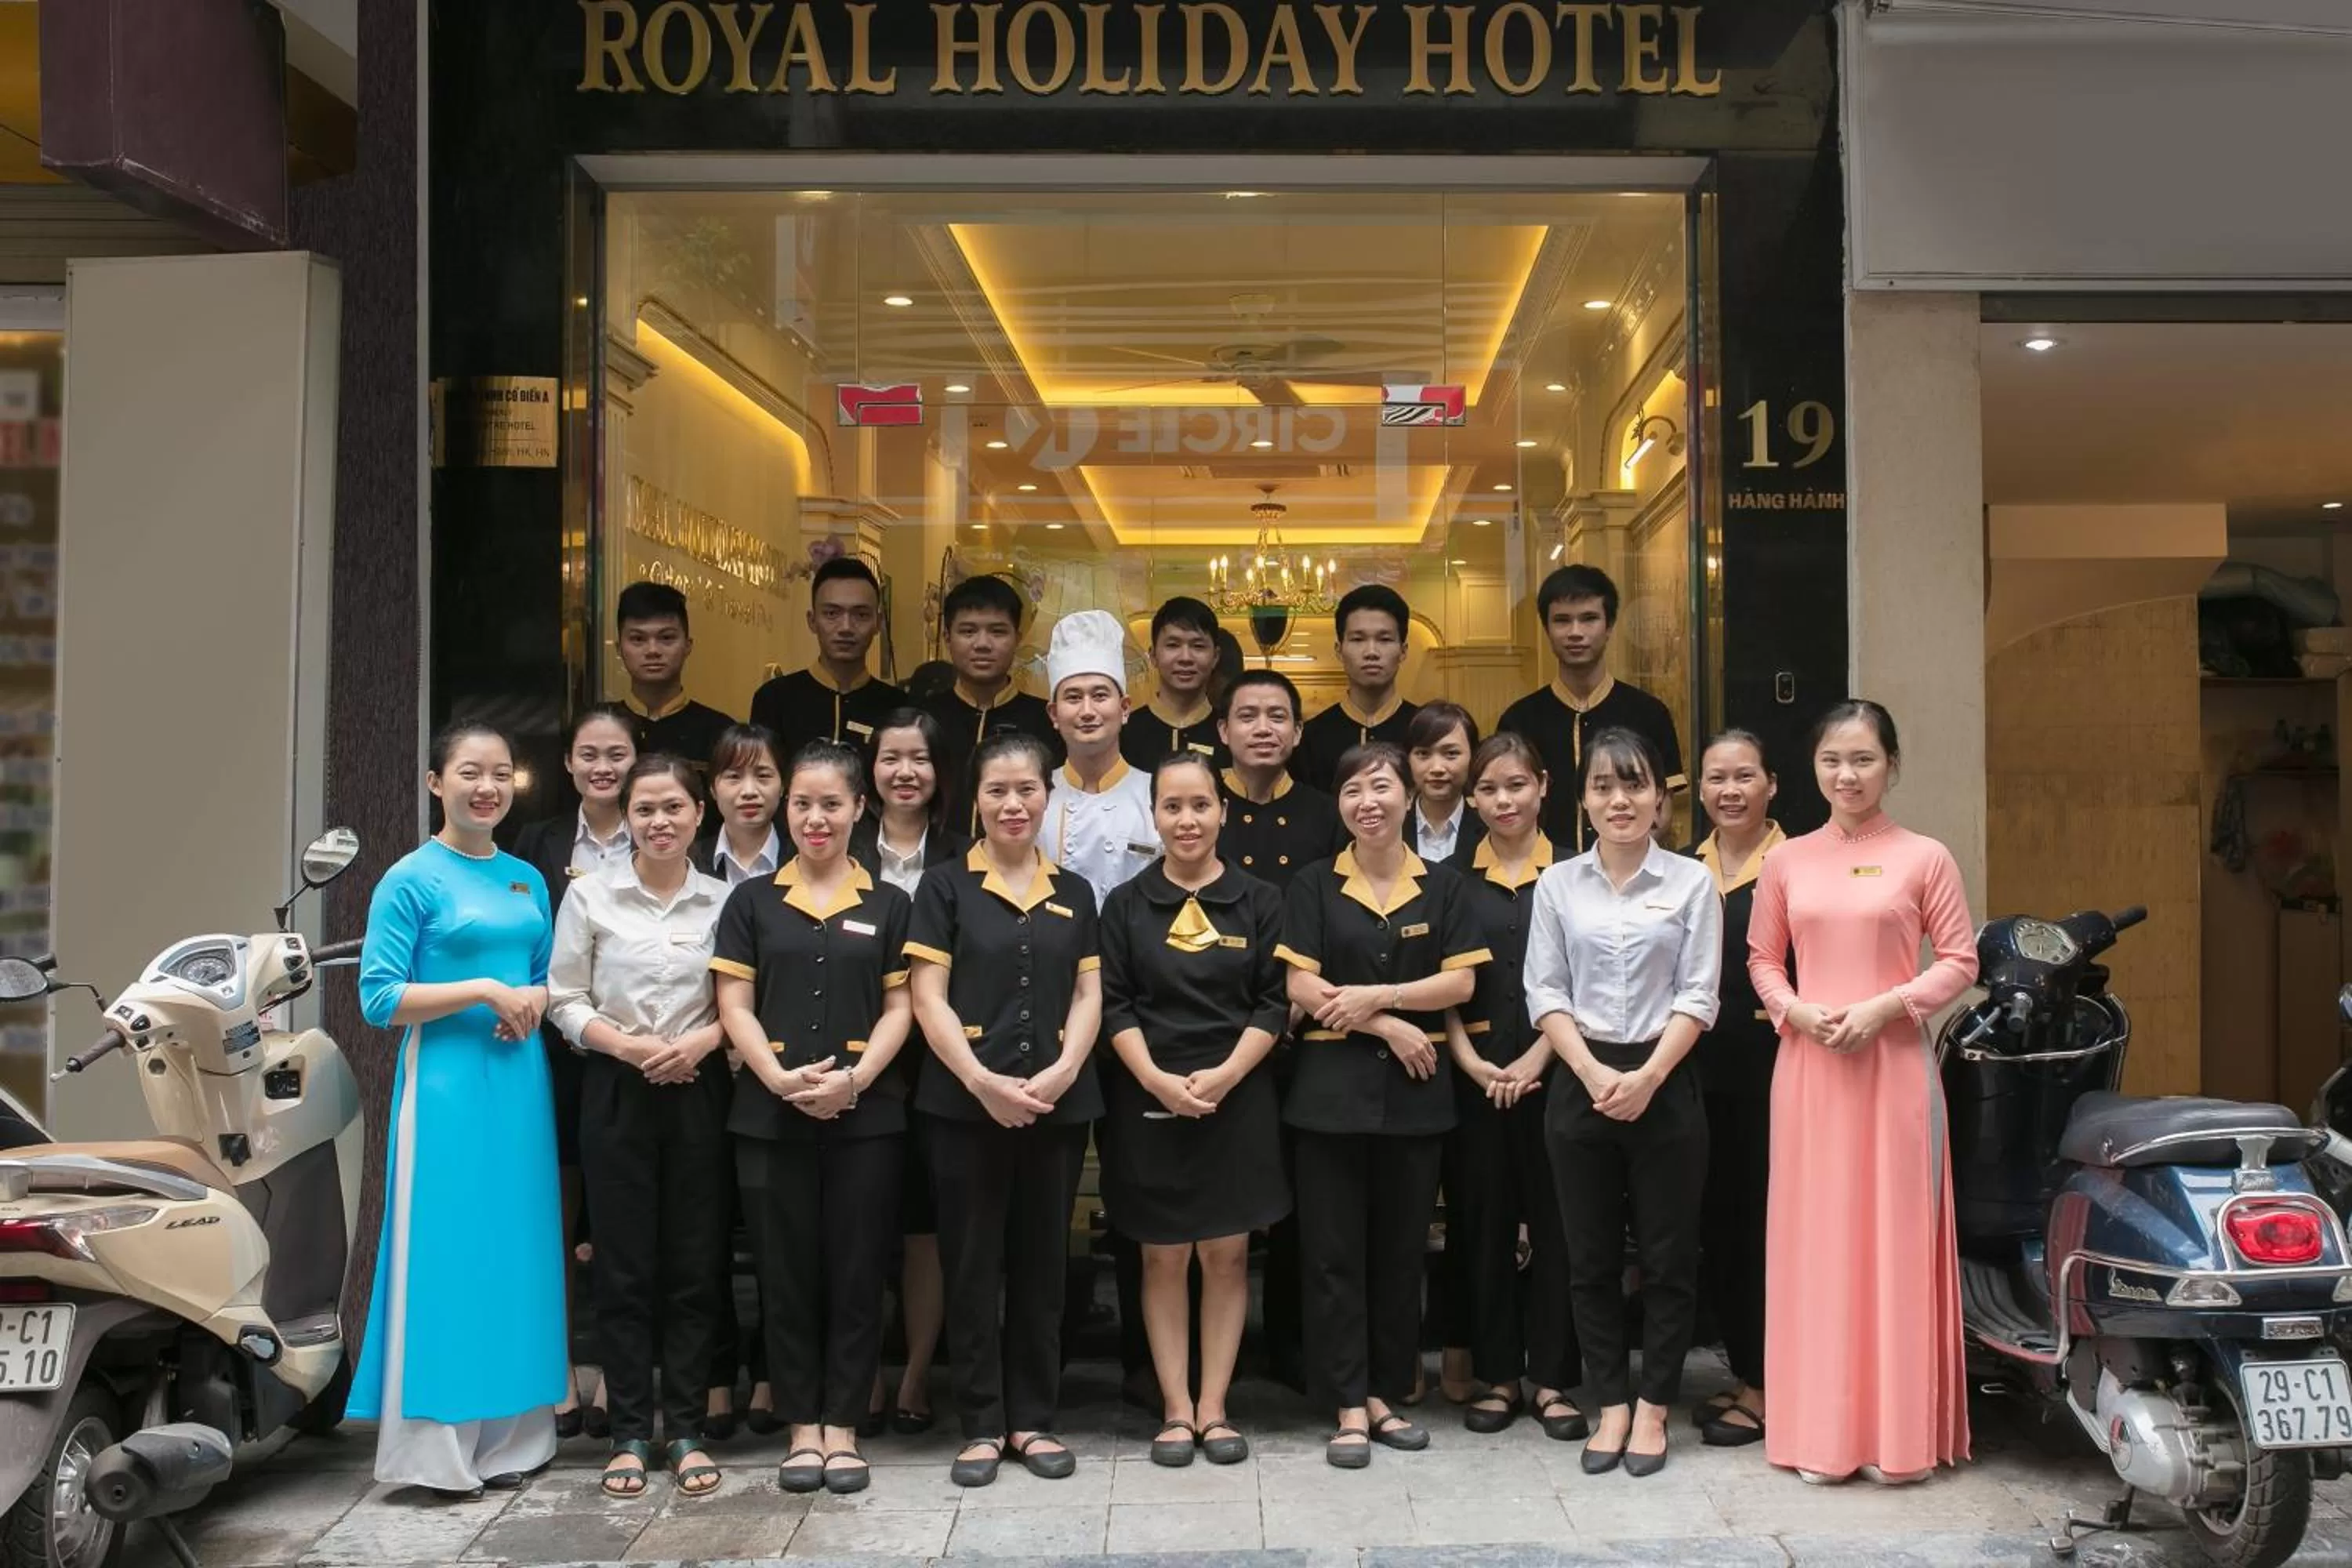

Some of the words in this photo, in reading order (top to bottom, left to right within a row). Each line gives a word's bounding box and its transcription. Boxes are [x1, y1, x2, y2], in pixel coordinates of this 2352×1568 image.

[575, 0, 898, 95] ROYAL
[929, 1, 1377, 96] HOLIDAY
[1402, 2, 1722, 96] HOTEL
[1737, 400, 1835, 469] 19
[1727, 487, 1785, 510] HÀNG
[1788, 486, 1845, 510] HÀNH
[164, 1216, 220, 1229] LEAD
[0, 1310, 53, 1345] -C1
[2258, 1367, 2336, 1404] 29-C1
[2257, 1406, 2352, 1443] 367.79
